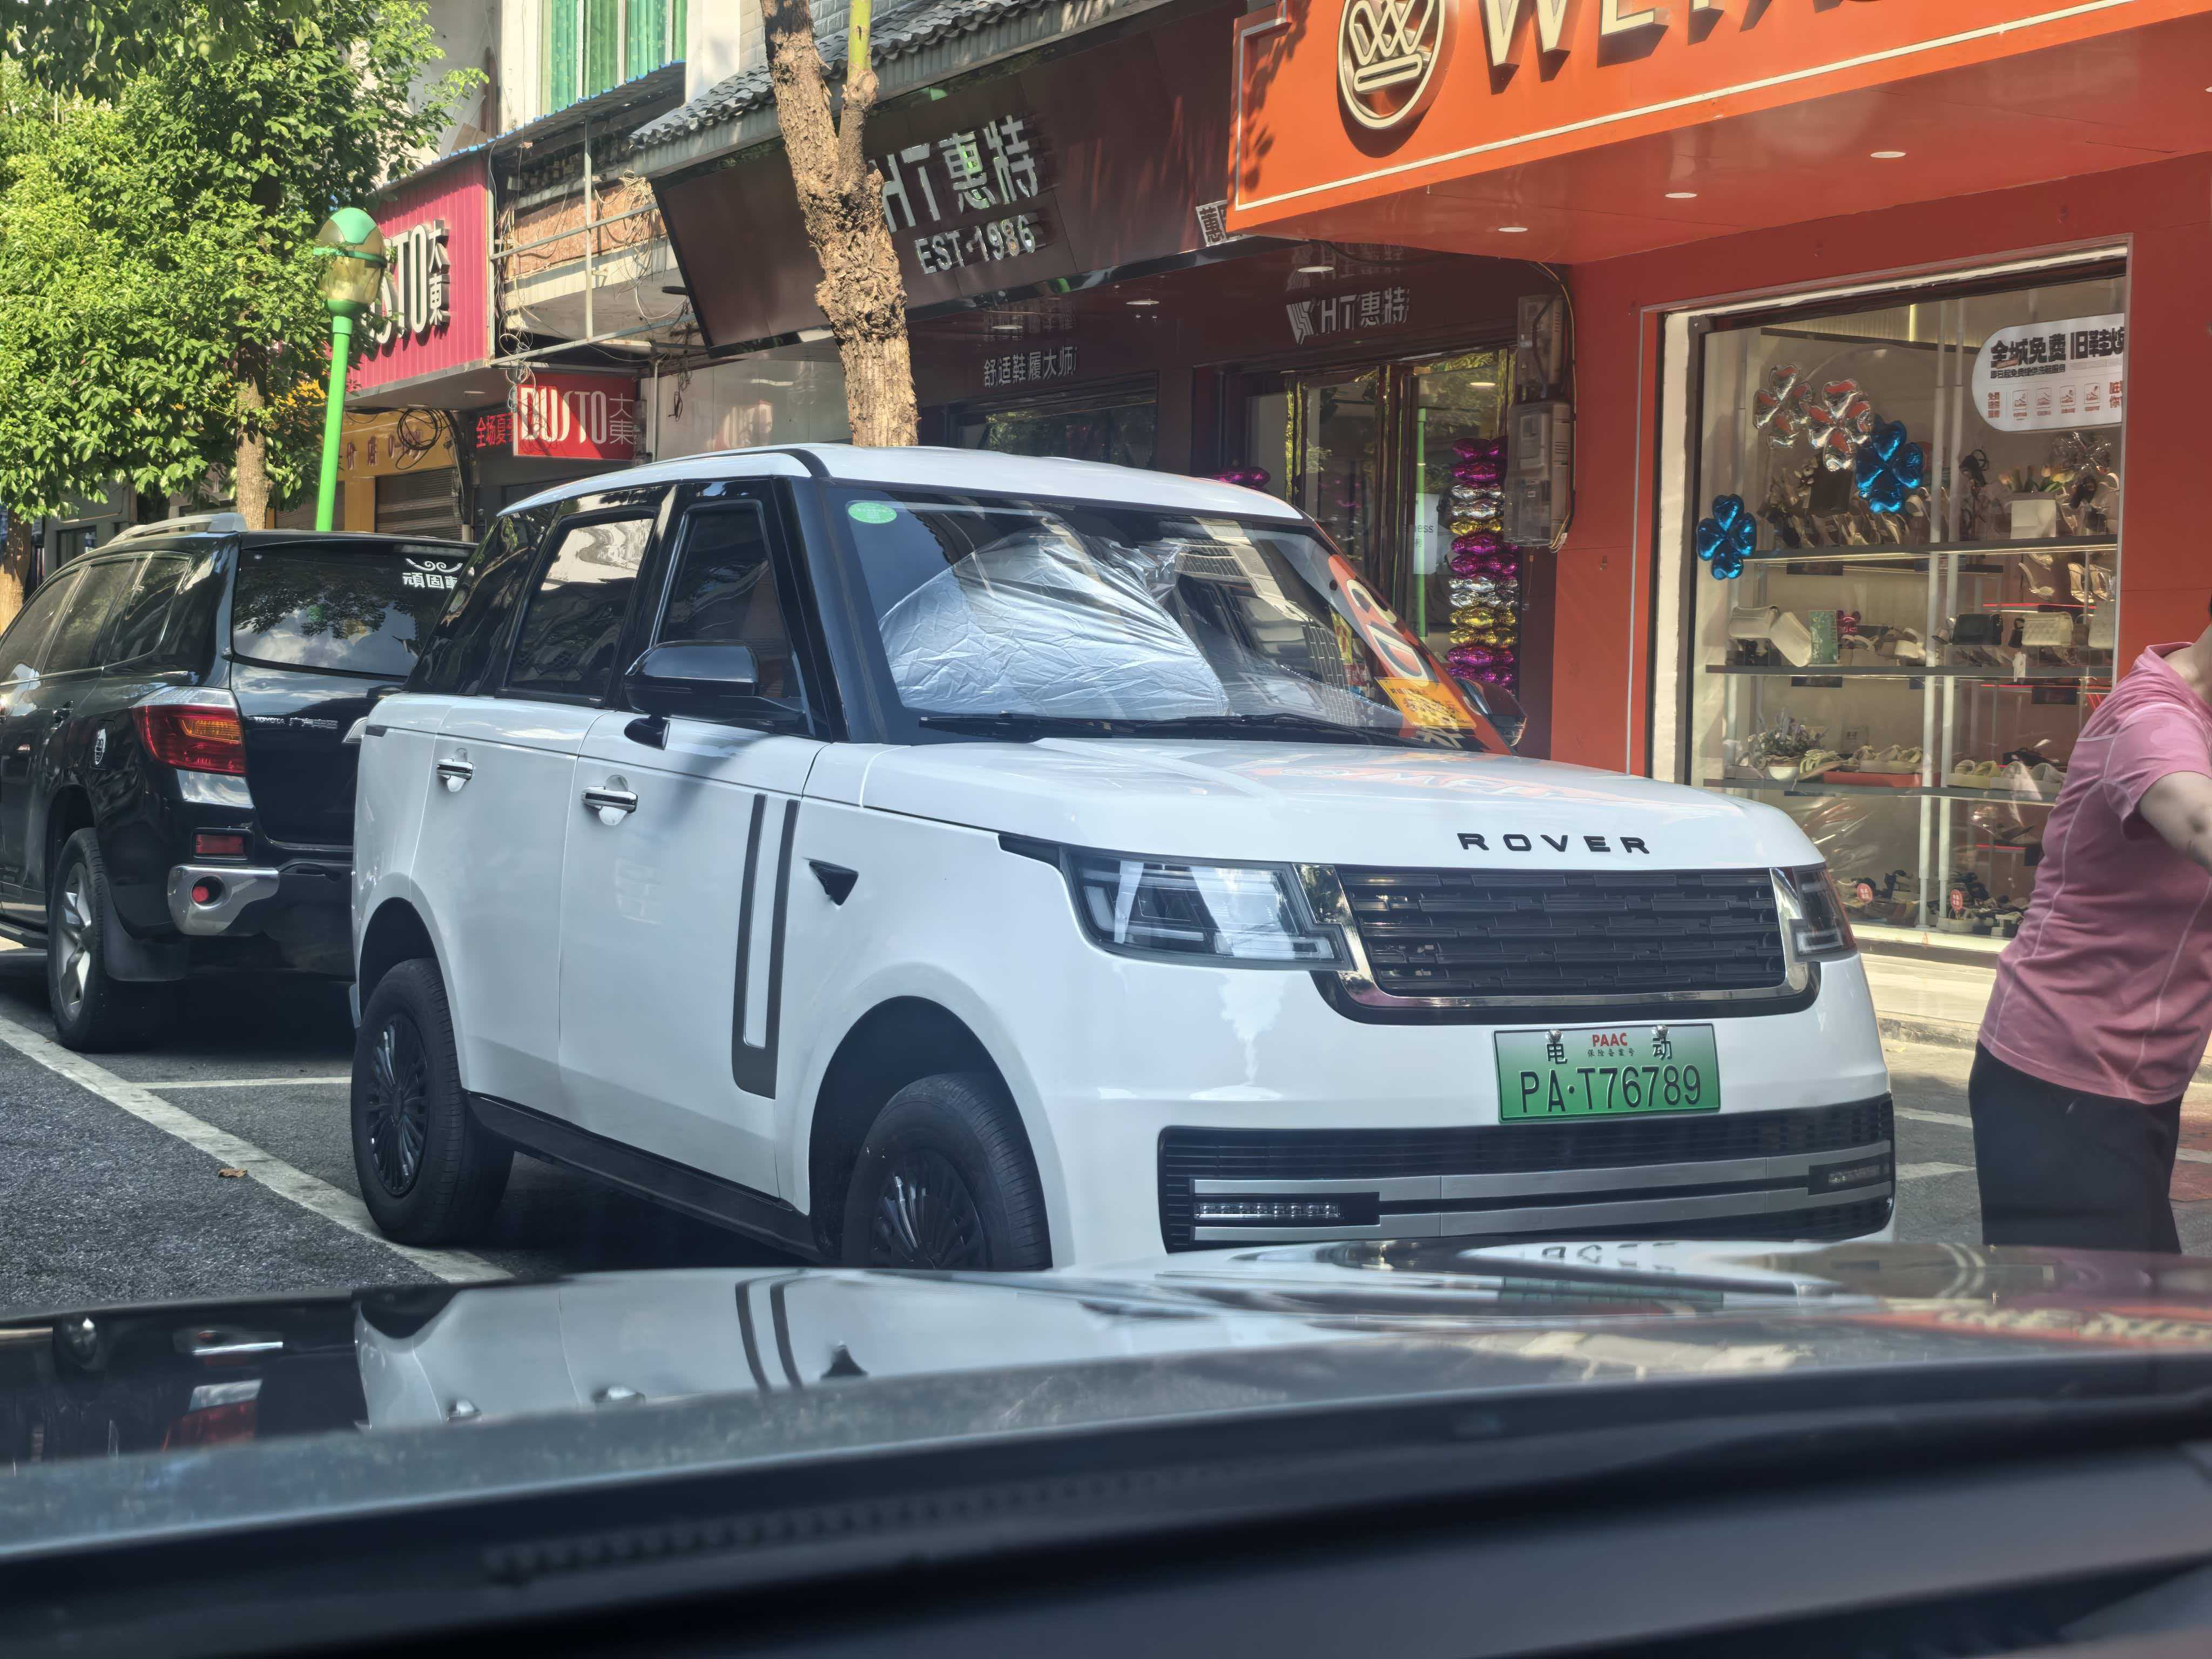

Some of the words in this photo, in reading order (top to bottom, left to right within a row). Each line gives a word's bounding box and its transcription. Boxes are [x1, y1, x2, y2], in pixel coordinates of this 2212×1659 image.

[984, 346, 1074, 388] 舒适鞋履大师
[521, 387, 606, 444] DUSTO
[1457, 833, 1650, 854] ROVER
[1592, 1032, 1628, 1047] PAAC
[1519, 1064, 1701, 1112] PA·T76789
